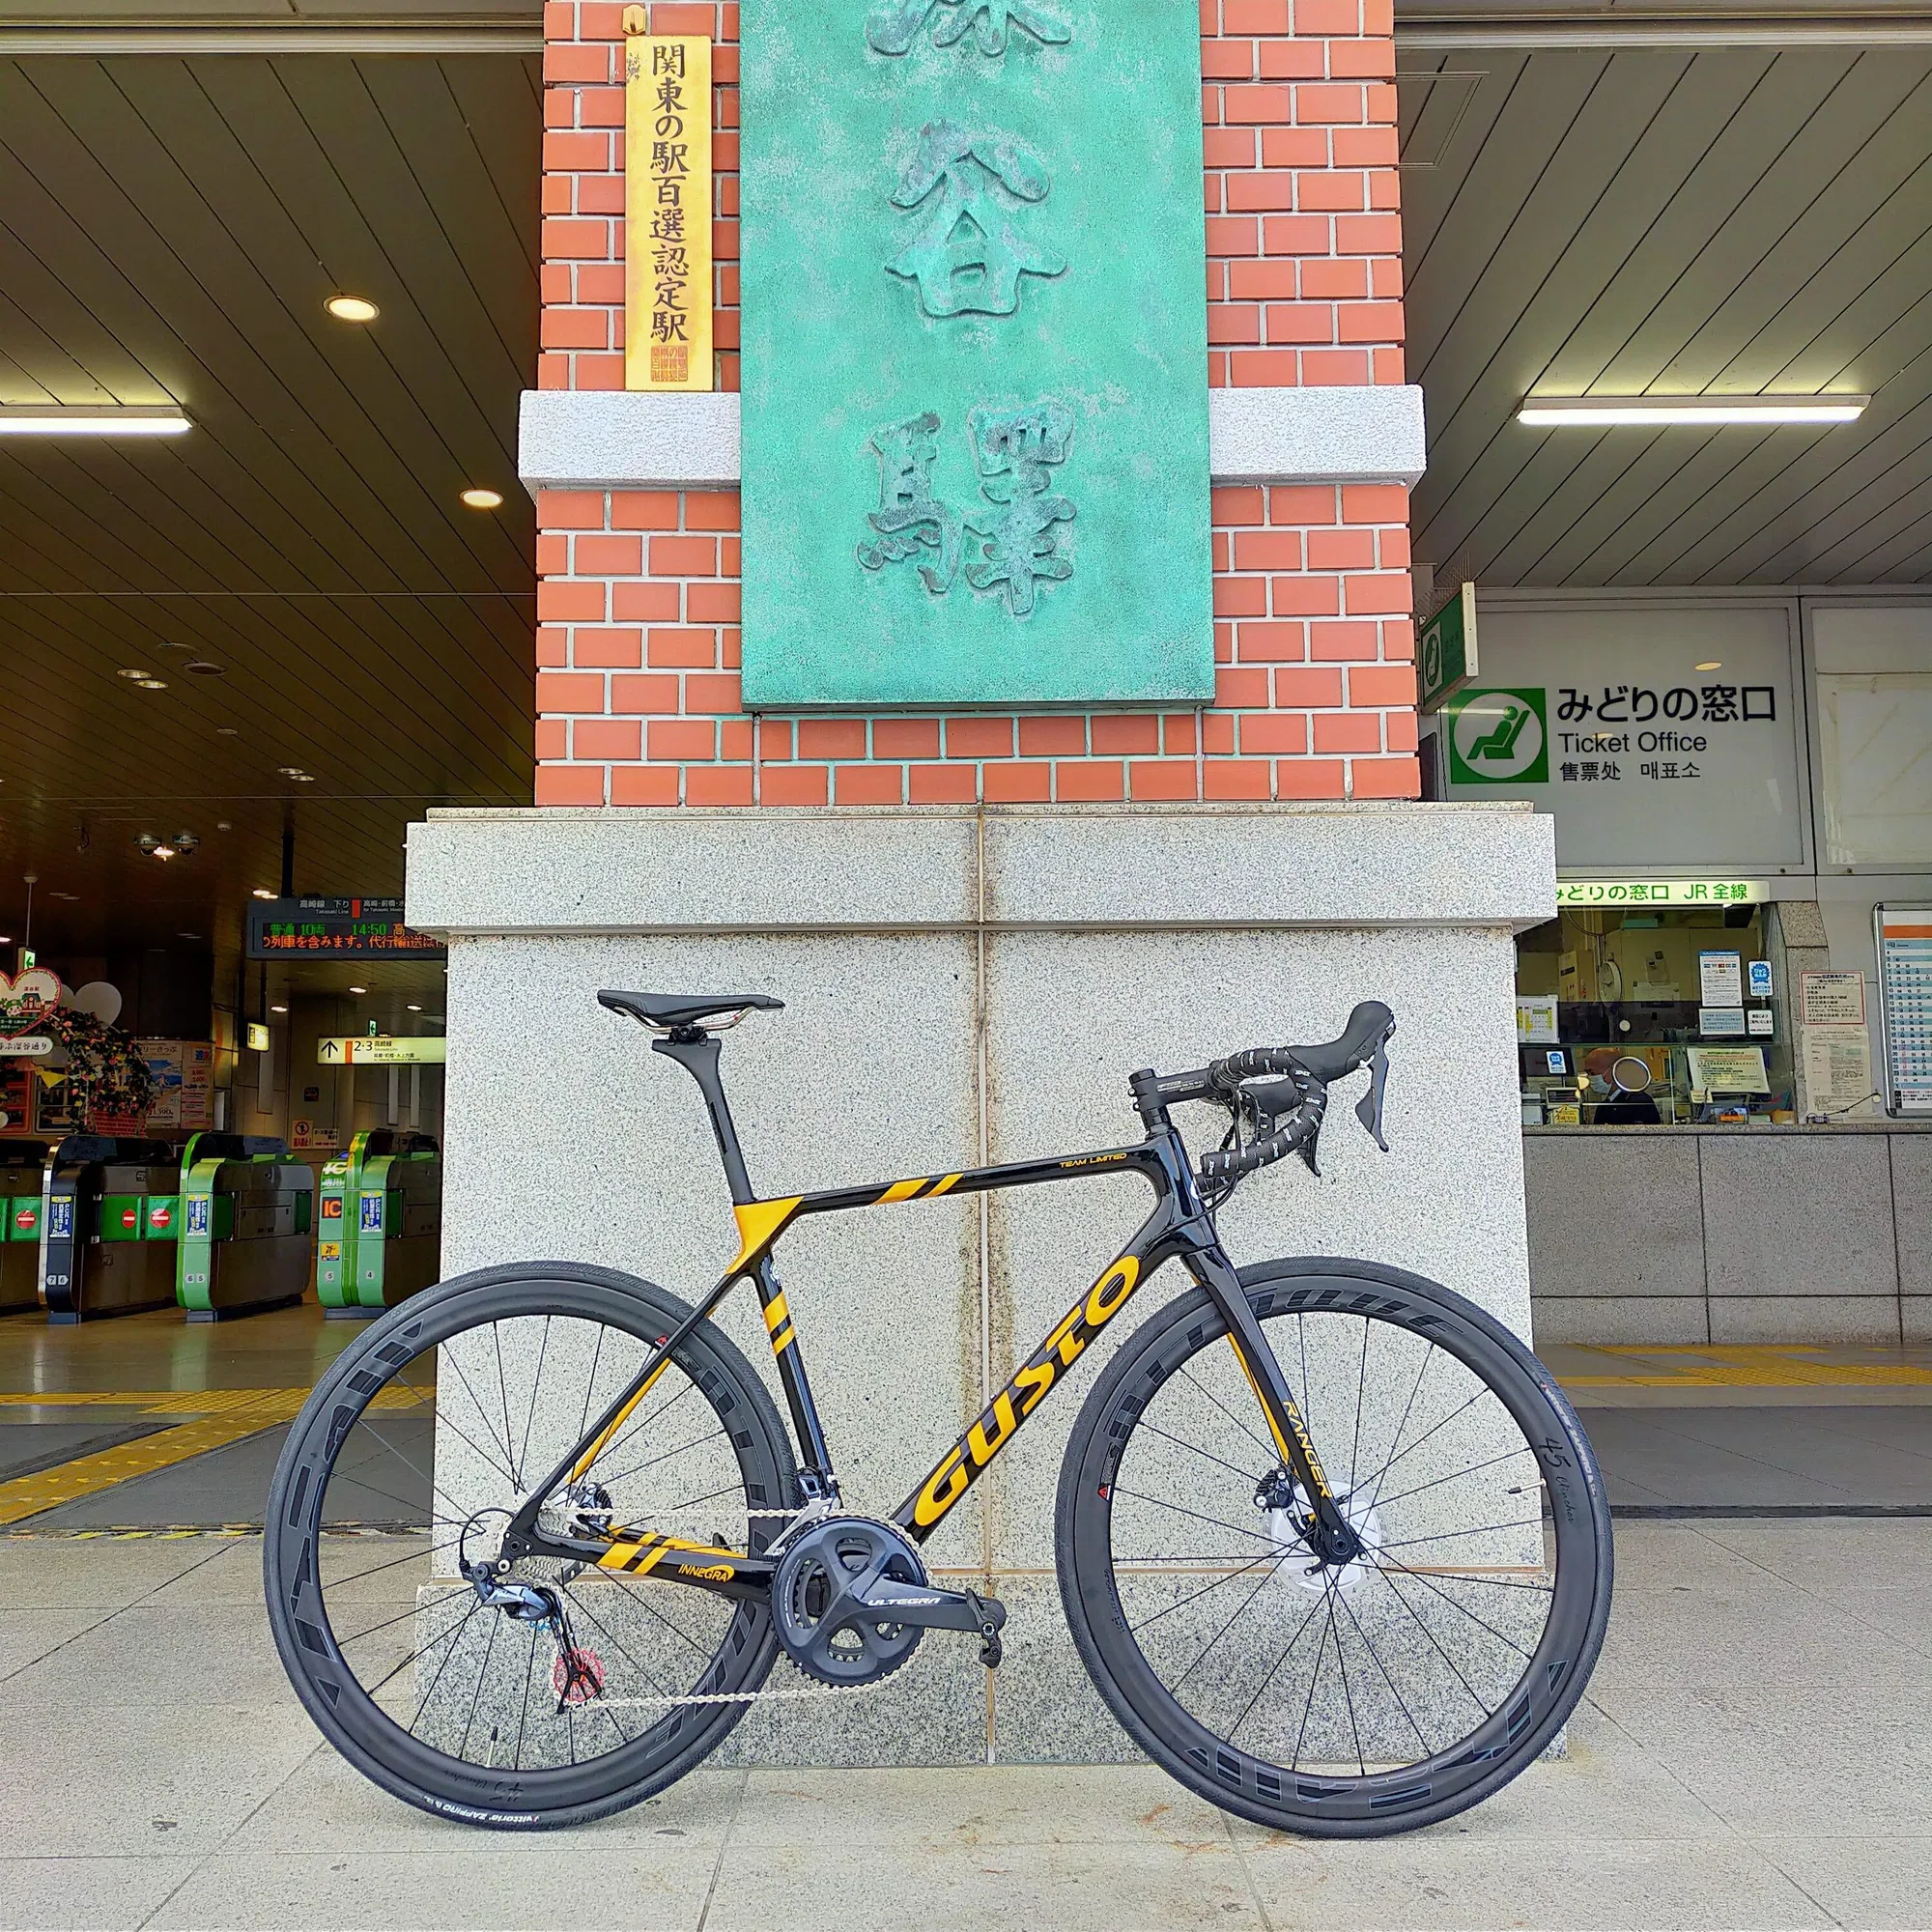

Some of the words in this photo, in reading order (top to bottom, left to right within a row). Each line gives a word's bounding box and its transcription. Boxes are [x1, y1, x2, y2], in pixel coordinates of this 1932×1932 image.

[649, 43, 691, 343] 関東の駅百選認定駅
[855, 0, 1078, 616] 谷驛
[1556, 684, 1776, 723] みどりの窓口
[1557, 732, 1631, 753] Ticket
[1637, 730, 1708, 753] Office
[1559, 760, 1622, 781] 售票处
[1639, 760, 1702, 781] 매표소
[1684, 884, 1708, 900] JR
[1713, 883, 1748, 900] 全線
[352, 923, 387, 935] 14:50
[1060, 1158, 1087, 1169] TEAM
[1089, 1152, 1127, 1165] LIMITED
[324, 1200, 342, 1217] IC
[914, 1255, 1140, 1526] GUSTO
[1283, 1400, 1332, 1498] RANGER
[1538, 1436, 1573, 1469] 45
[677, 1563, 734, 1583] INNEGRA
[867, 1596, 942, 1607] ULTEGRA
